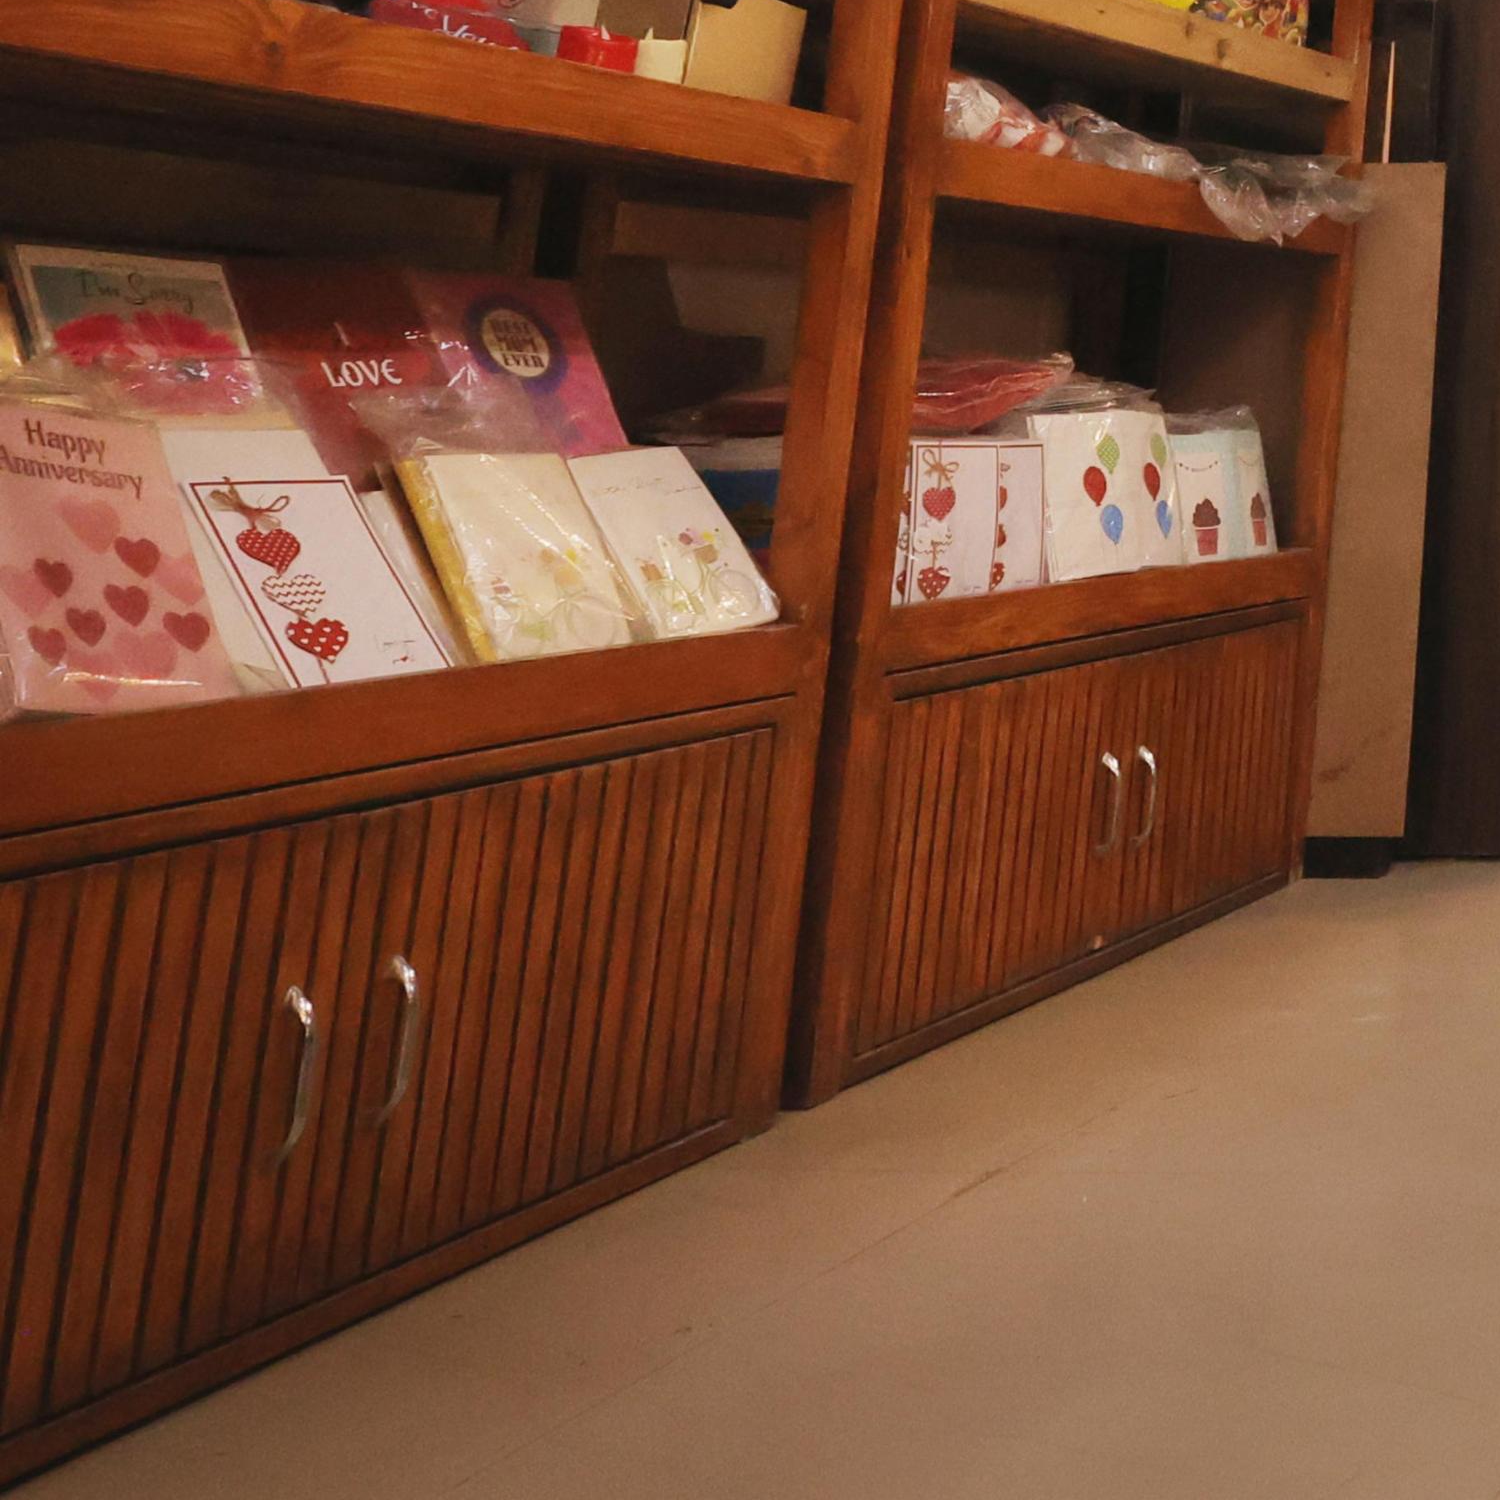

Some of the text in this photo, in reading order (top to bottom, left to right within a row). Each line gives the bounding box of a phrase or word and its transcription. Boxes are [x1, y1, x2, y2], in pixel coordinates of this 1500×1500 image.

[321, 358, 403, 388] LOVE
[24, 418, 106, 466] Happy
[0, 444, 143, 500] Anniversary
